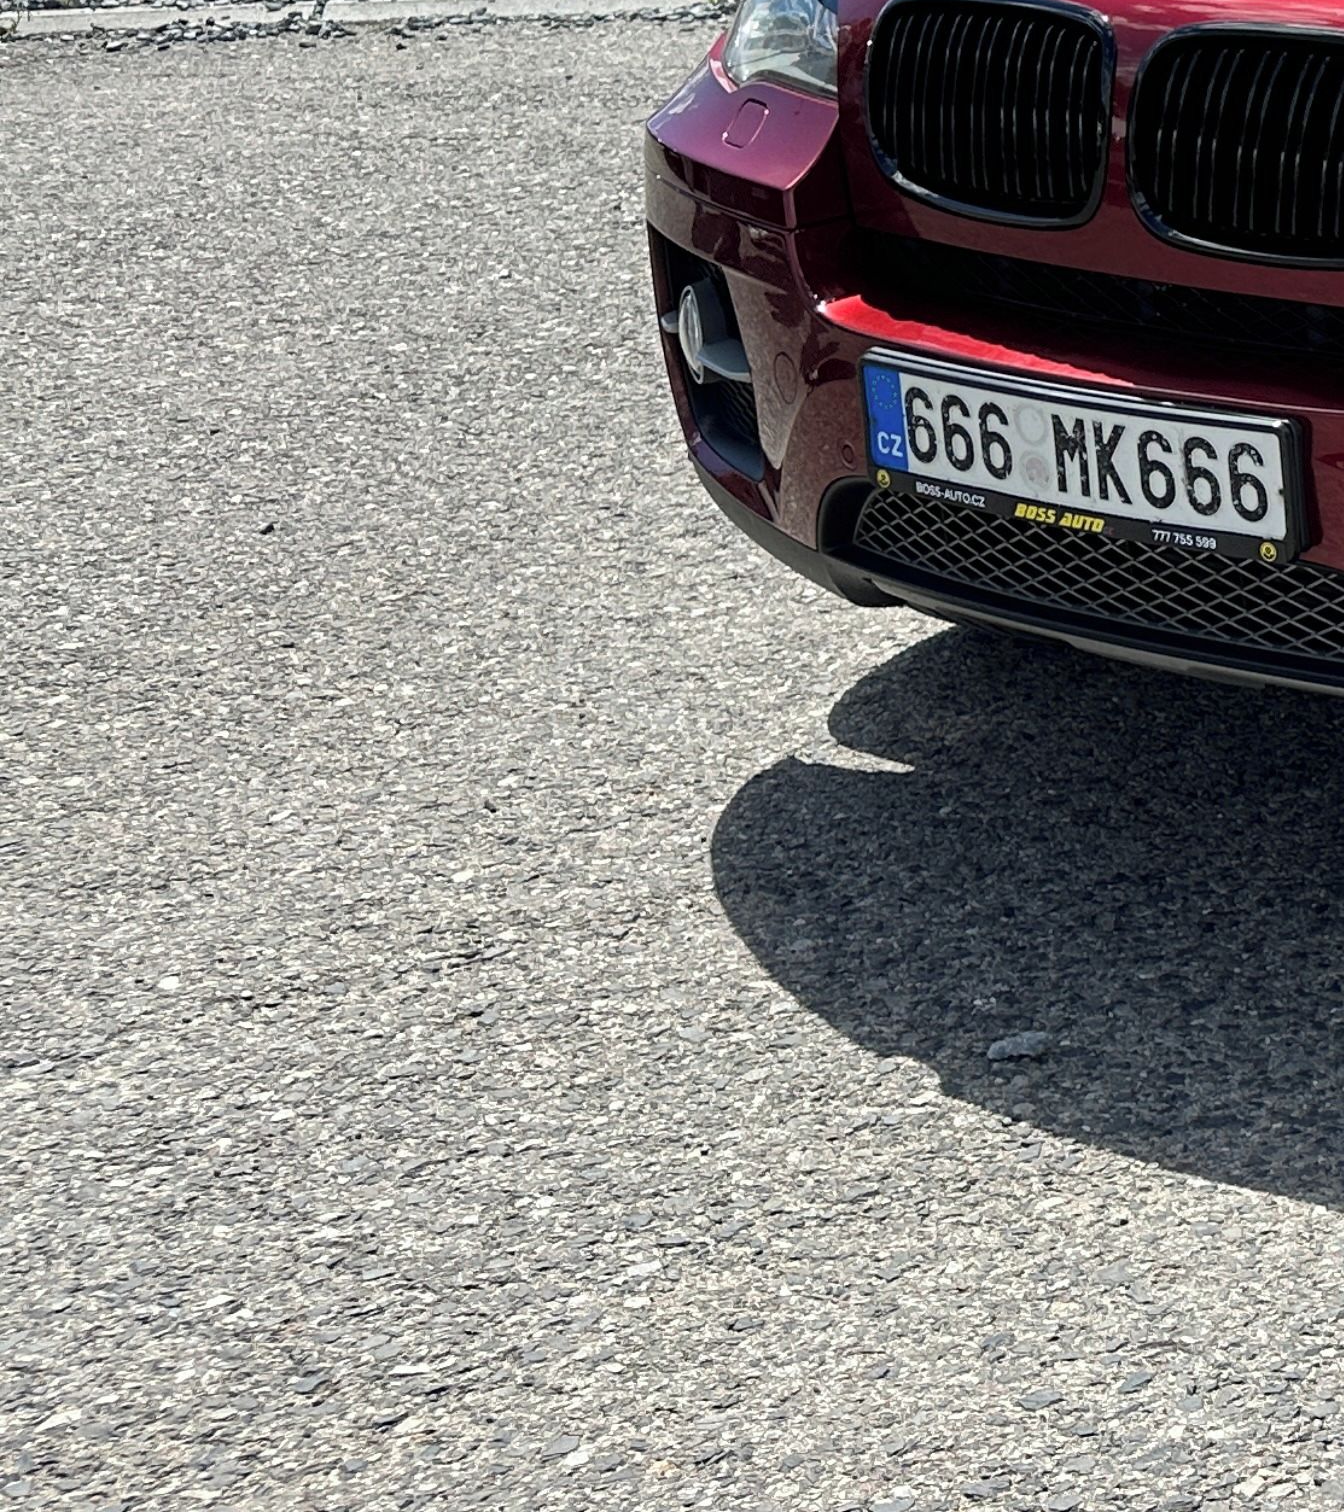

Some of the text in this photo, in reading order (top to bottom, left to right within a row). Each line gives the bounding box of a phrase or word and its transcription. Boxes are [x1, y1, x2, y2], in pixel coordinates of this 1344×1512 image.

[877, 431, 904, 458] CZ
[904, 386, 1013, 480] 666
[1014, 503, 1057, 524] BOSS
[1059, 512, 1105, 533] AUTO
[1152, 530, 1170, 542] 777
[1173, 534, 1193, 546] 755
